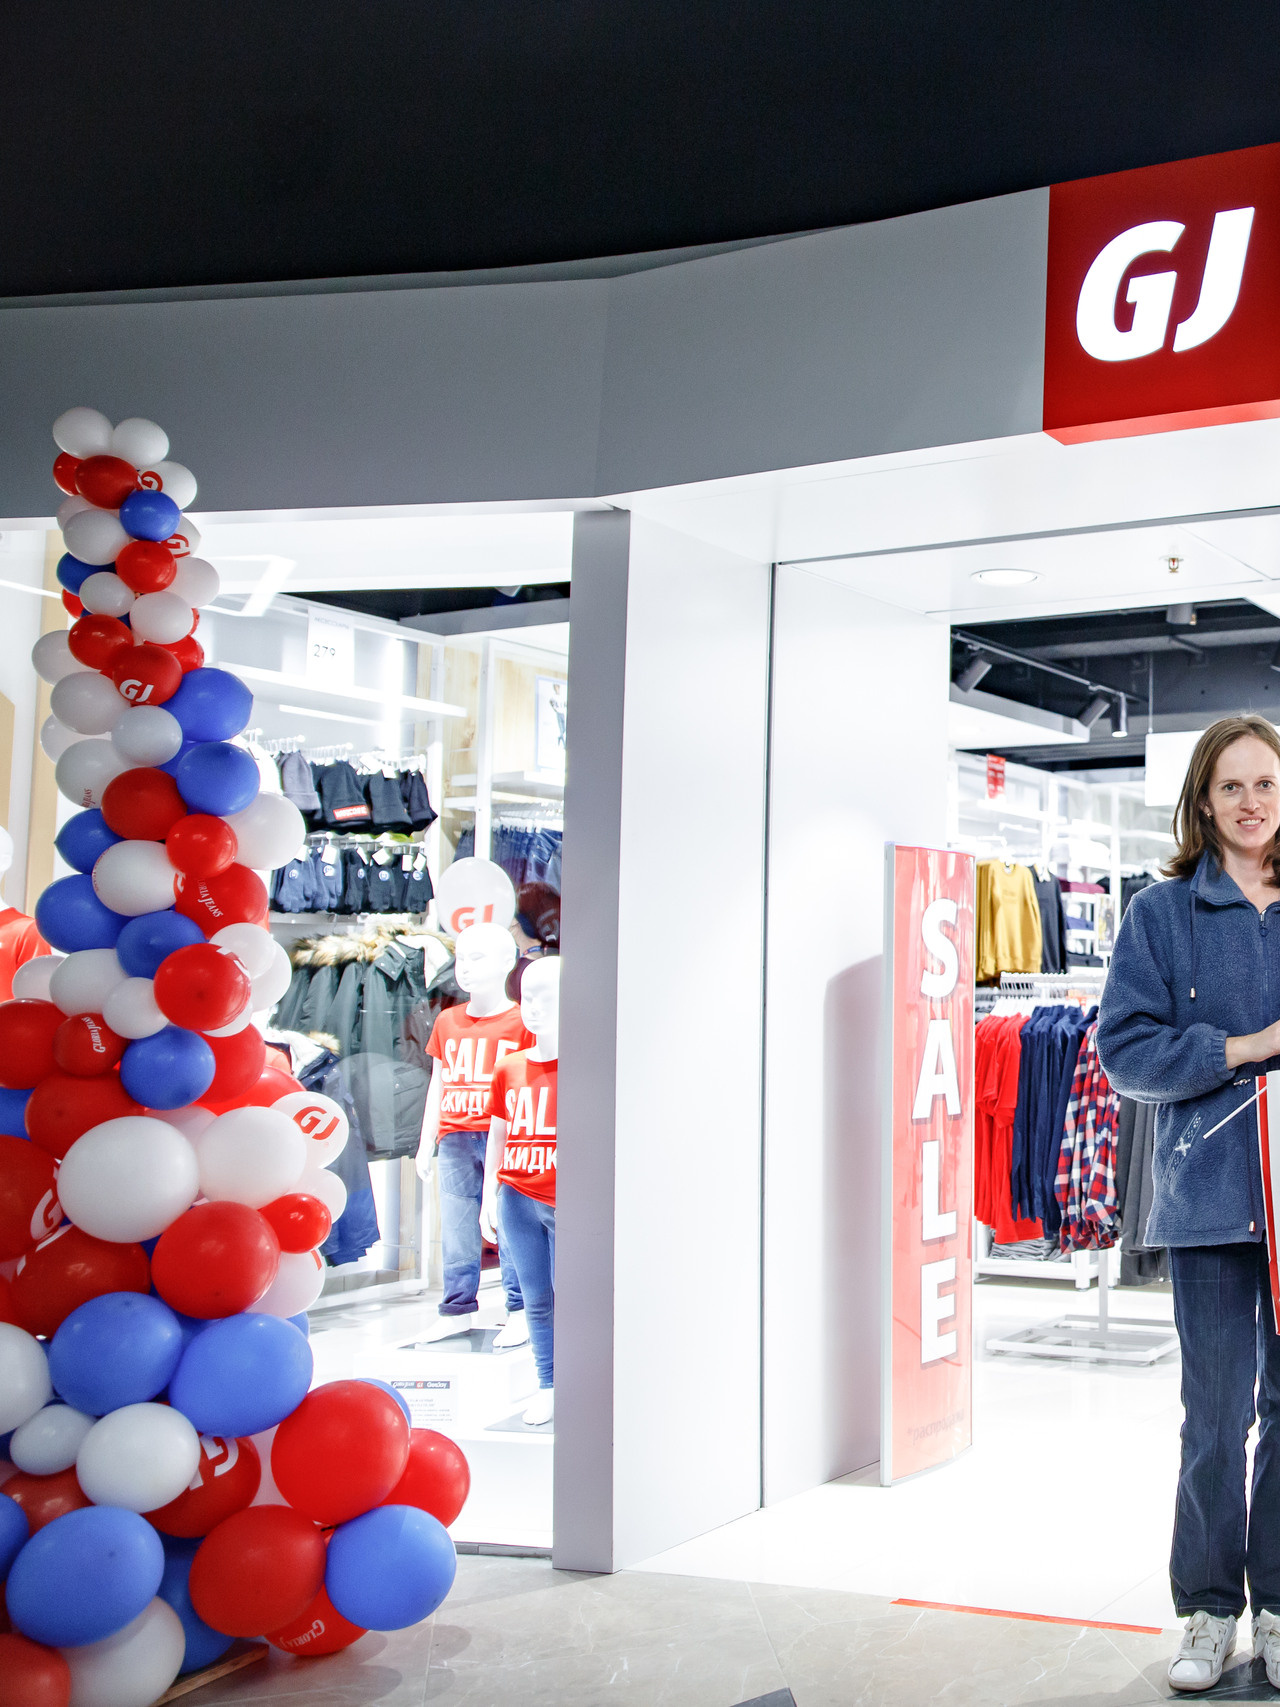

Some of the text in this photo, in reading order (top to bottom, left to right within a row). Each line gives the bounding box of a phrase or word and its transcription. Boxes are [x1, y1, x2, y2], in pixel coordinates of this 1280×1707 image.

[1075, 205, 1256, 363] GJ
[119, 679, 154, 703] GJ
[197, 897, 224, 918] JEANS
[293, 1106, 340, 1140] GJ
[505, 1087, 557, 1136] SAL
[911, 897, 962, 1367] SALE
